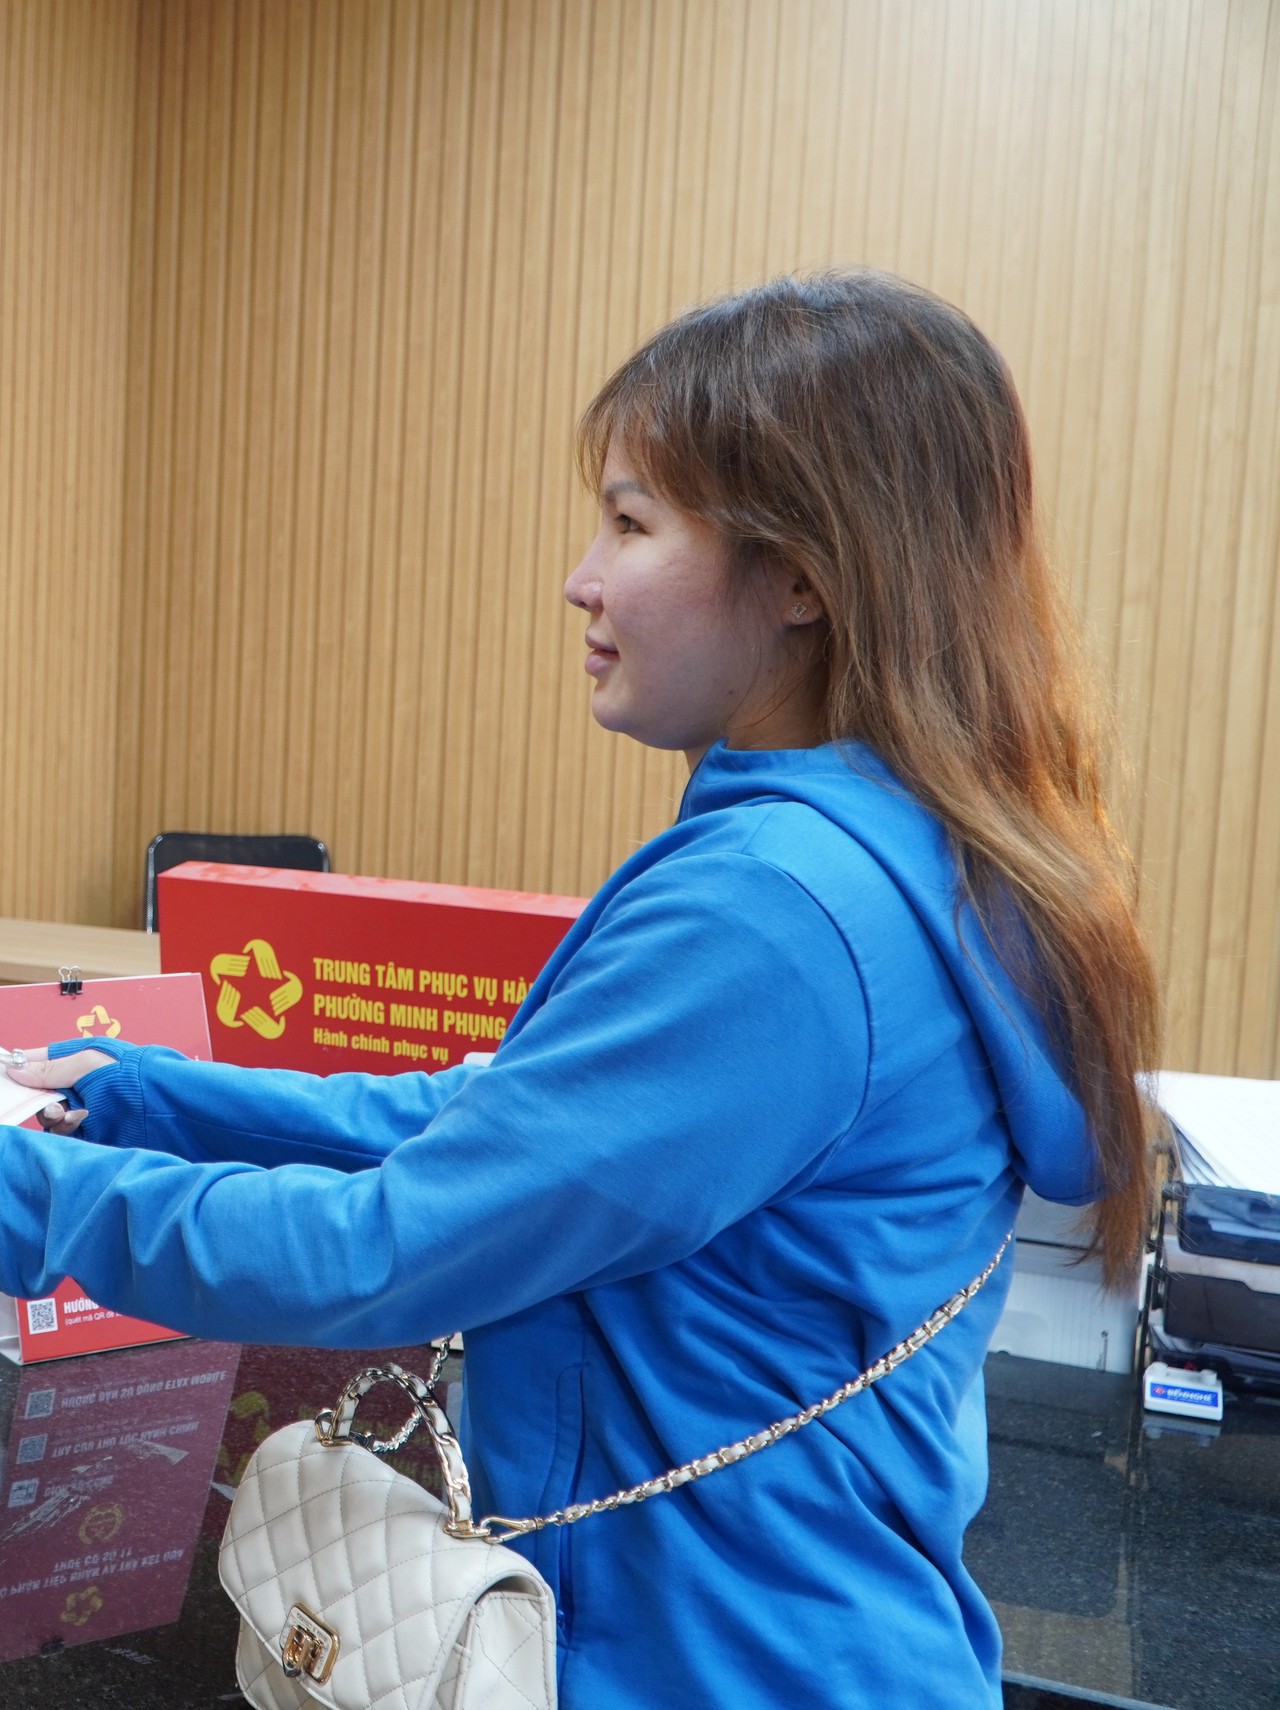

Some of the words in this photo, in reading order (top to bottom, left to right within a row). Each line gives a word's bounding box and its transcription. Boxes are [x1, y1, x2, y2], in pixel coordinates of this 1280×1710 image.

[313, 956, 371, 986] TRUNG
[375, 960, 415, 992] TÂM
[419, 968, 469, 1002] PHỤC
[473, 975, 499, 1005] VỤ
[503, 976, 534, 1005] HÀ
[313, 991, 385, 1025] PHƯỜNG
[390, 1004, 439, 1032] MINH
[443, 1010, 507, 1042] PHỤNG
[313, 1027, 349, 1048] Hành
[351, 1033, 390, 1057] chính
[393, 1041, 429, 1062] phục
[431, 1047, 450, 1066] vụ
[94, 1311, 105, 1320] QR
